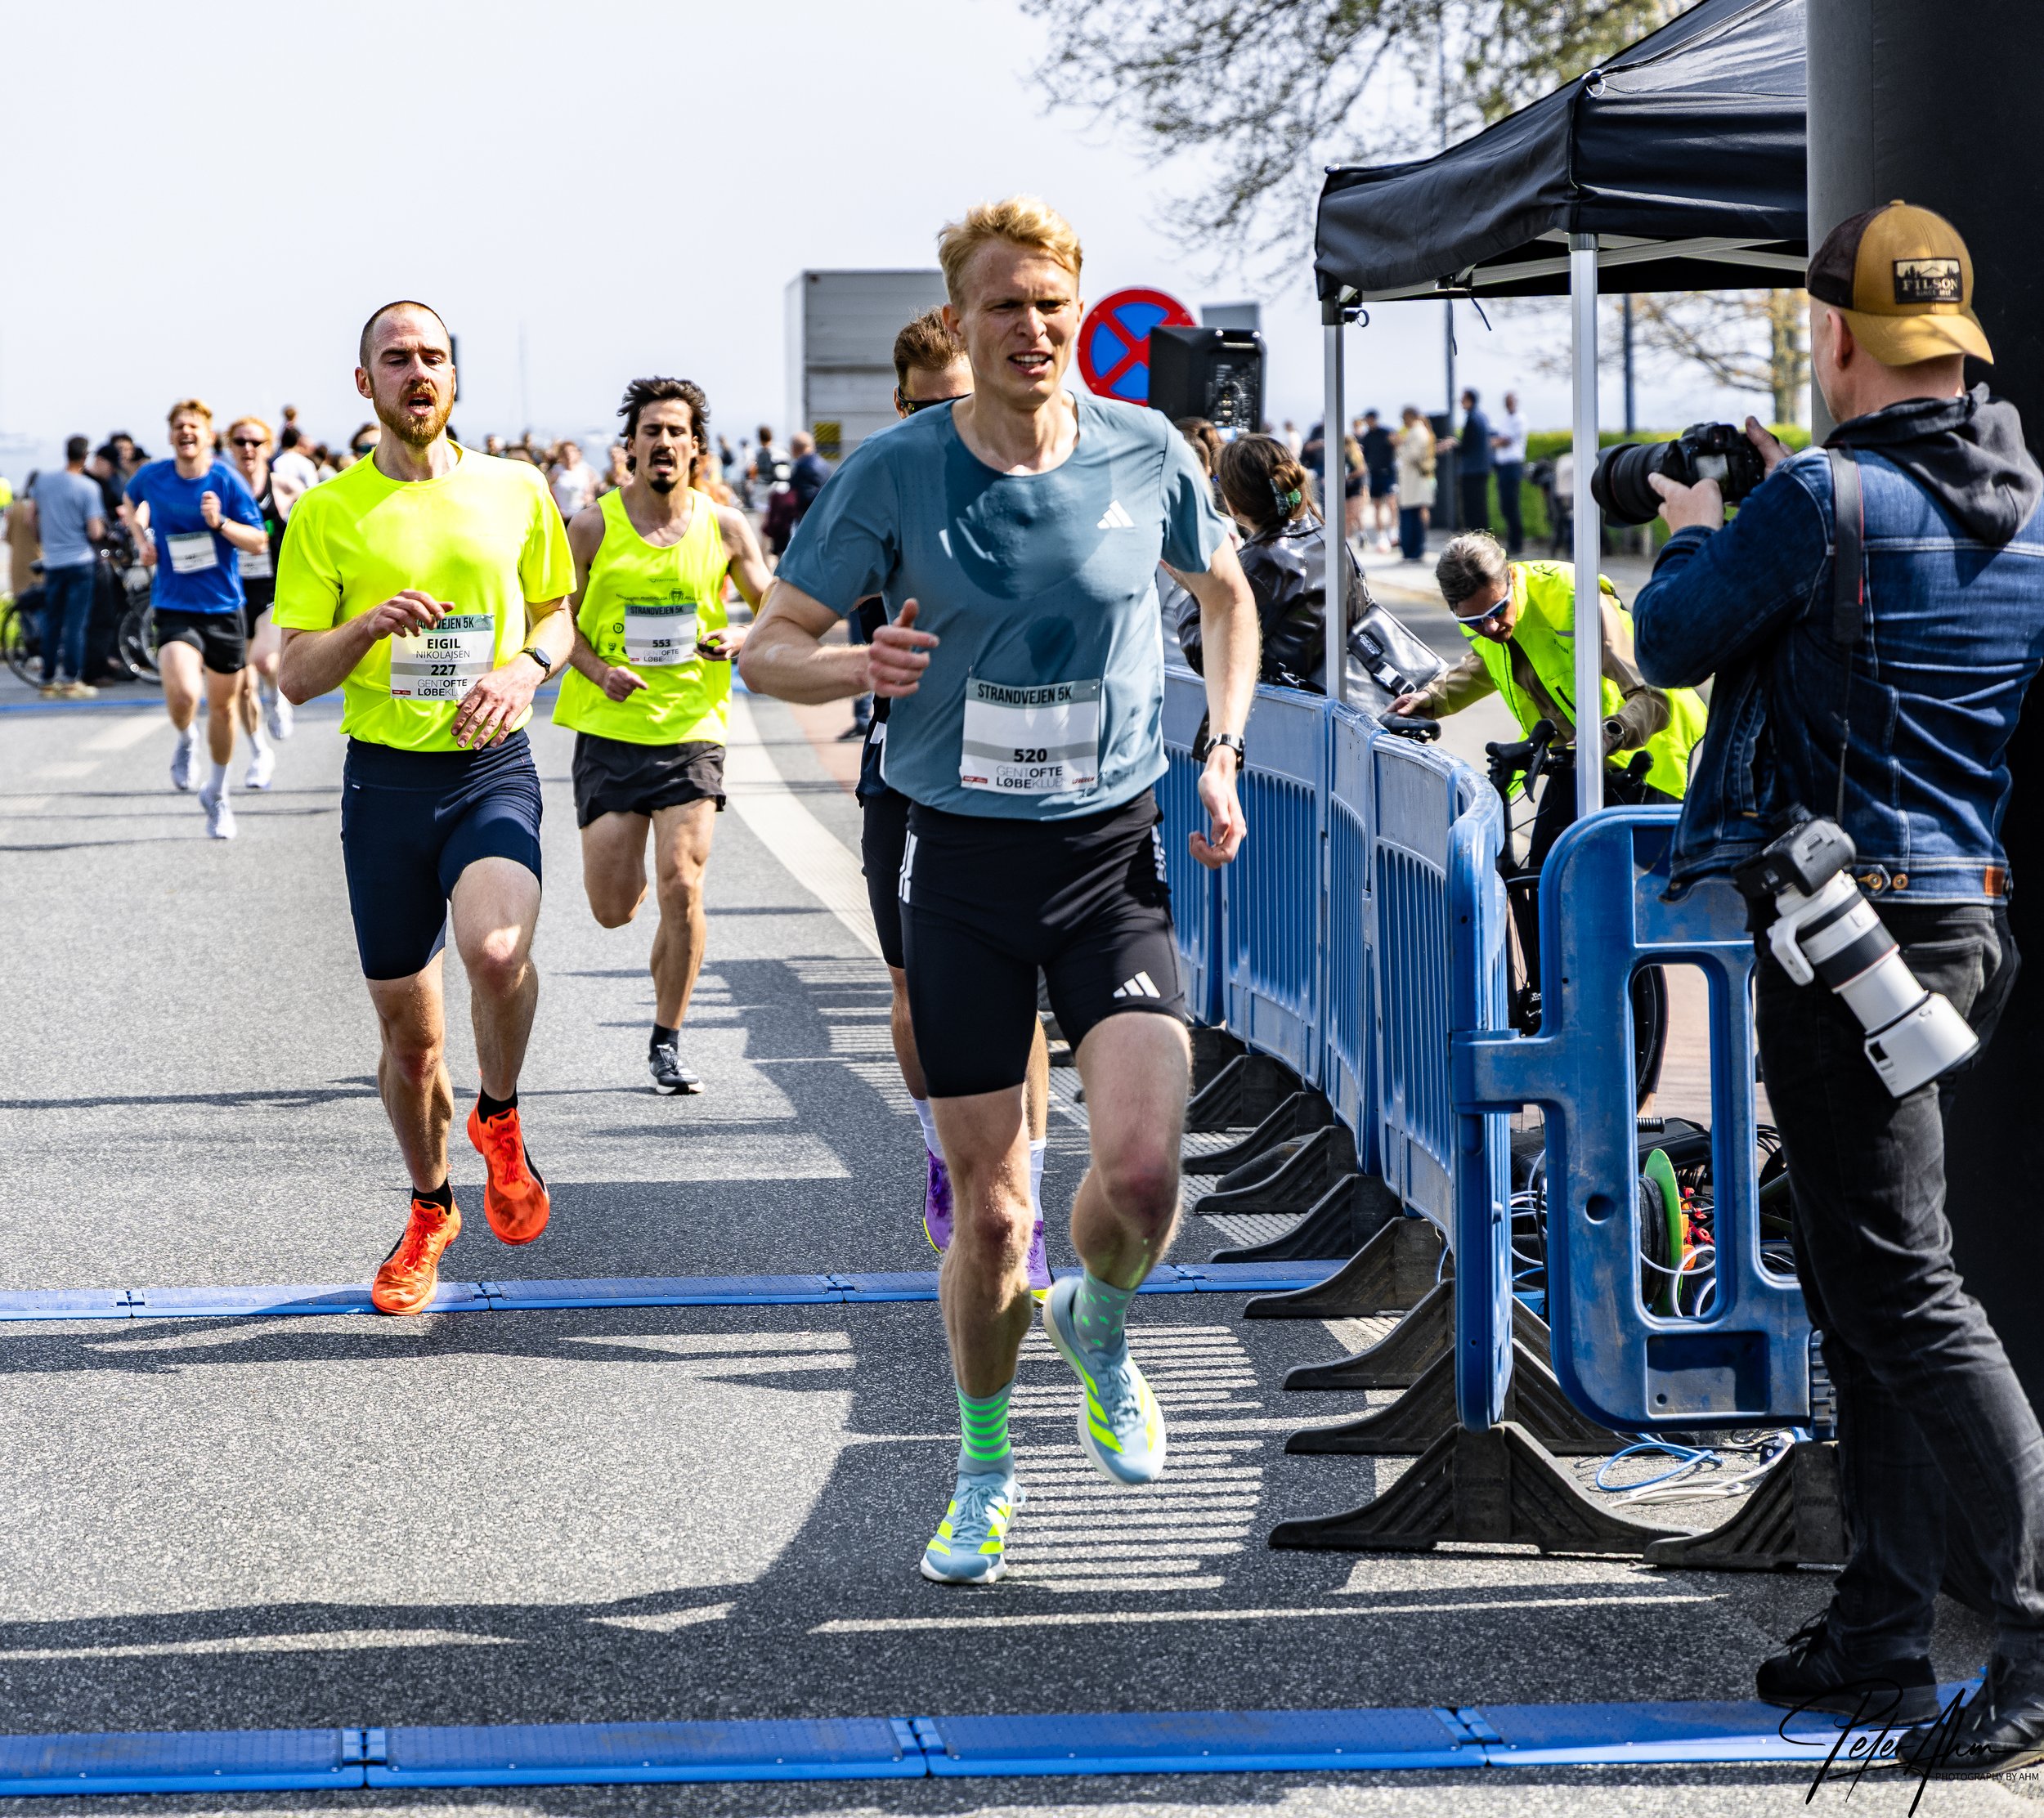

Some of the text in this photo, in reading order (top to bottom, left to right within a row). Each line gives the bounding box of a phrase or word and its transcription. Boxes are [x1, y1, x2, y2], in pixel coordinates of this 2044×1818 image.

[1903, 278, 1958, 291] FILSON
[630, 606, 684, 615] STRANDVEJEN 5K
[464, 616, 474, 629] 5K
[427, 638, 460, 649] EIGIL
[652, 639, 670, 647] 553
[415, 651, 470, 660] NIKOLAJSEN
[430, 664, 456, 676] 227
[417, 678, 468, 687] GENTOFTE
[978, 683, 1072, 705] STRANDVEJEN 5K
[1014, 748, 1047, 763] 520
[997, 765, 1062, 778] GENTOFTE
[997, 776, 1063, 789] LØBEKLUB
